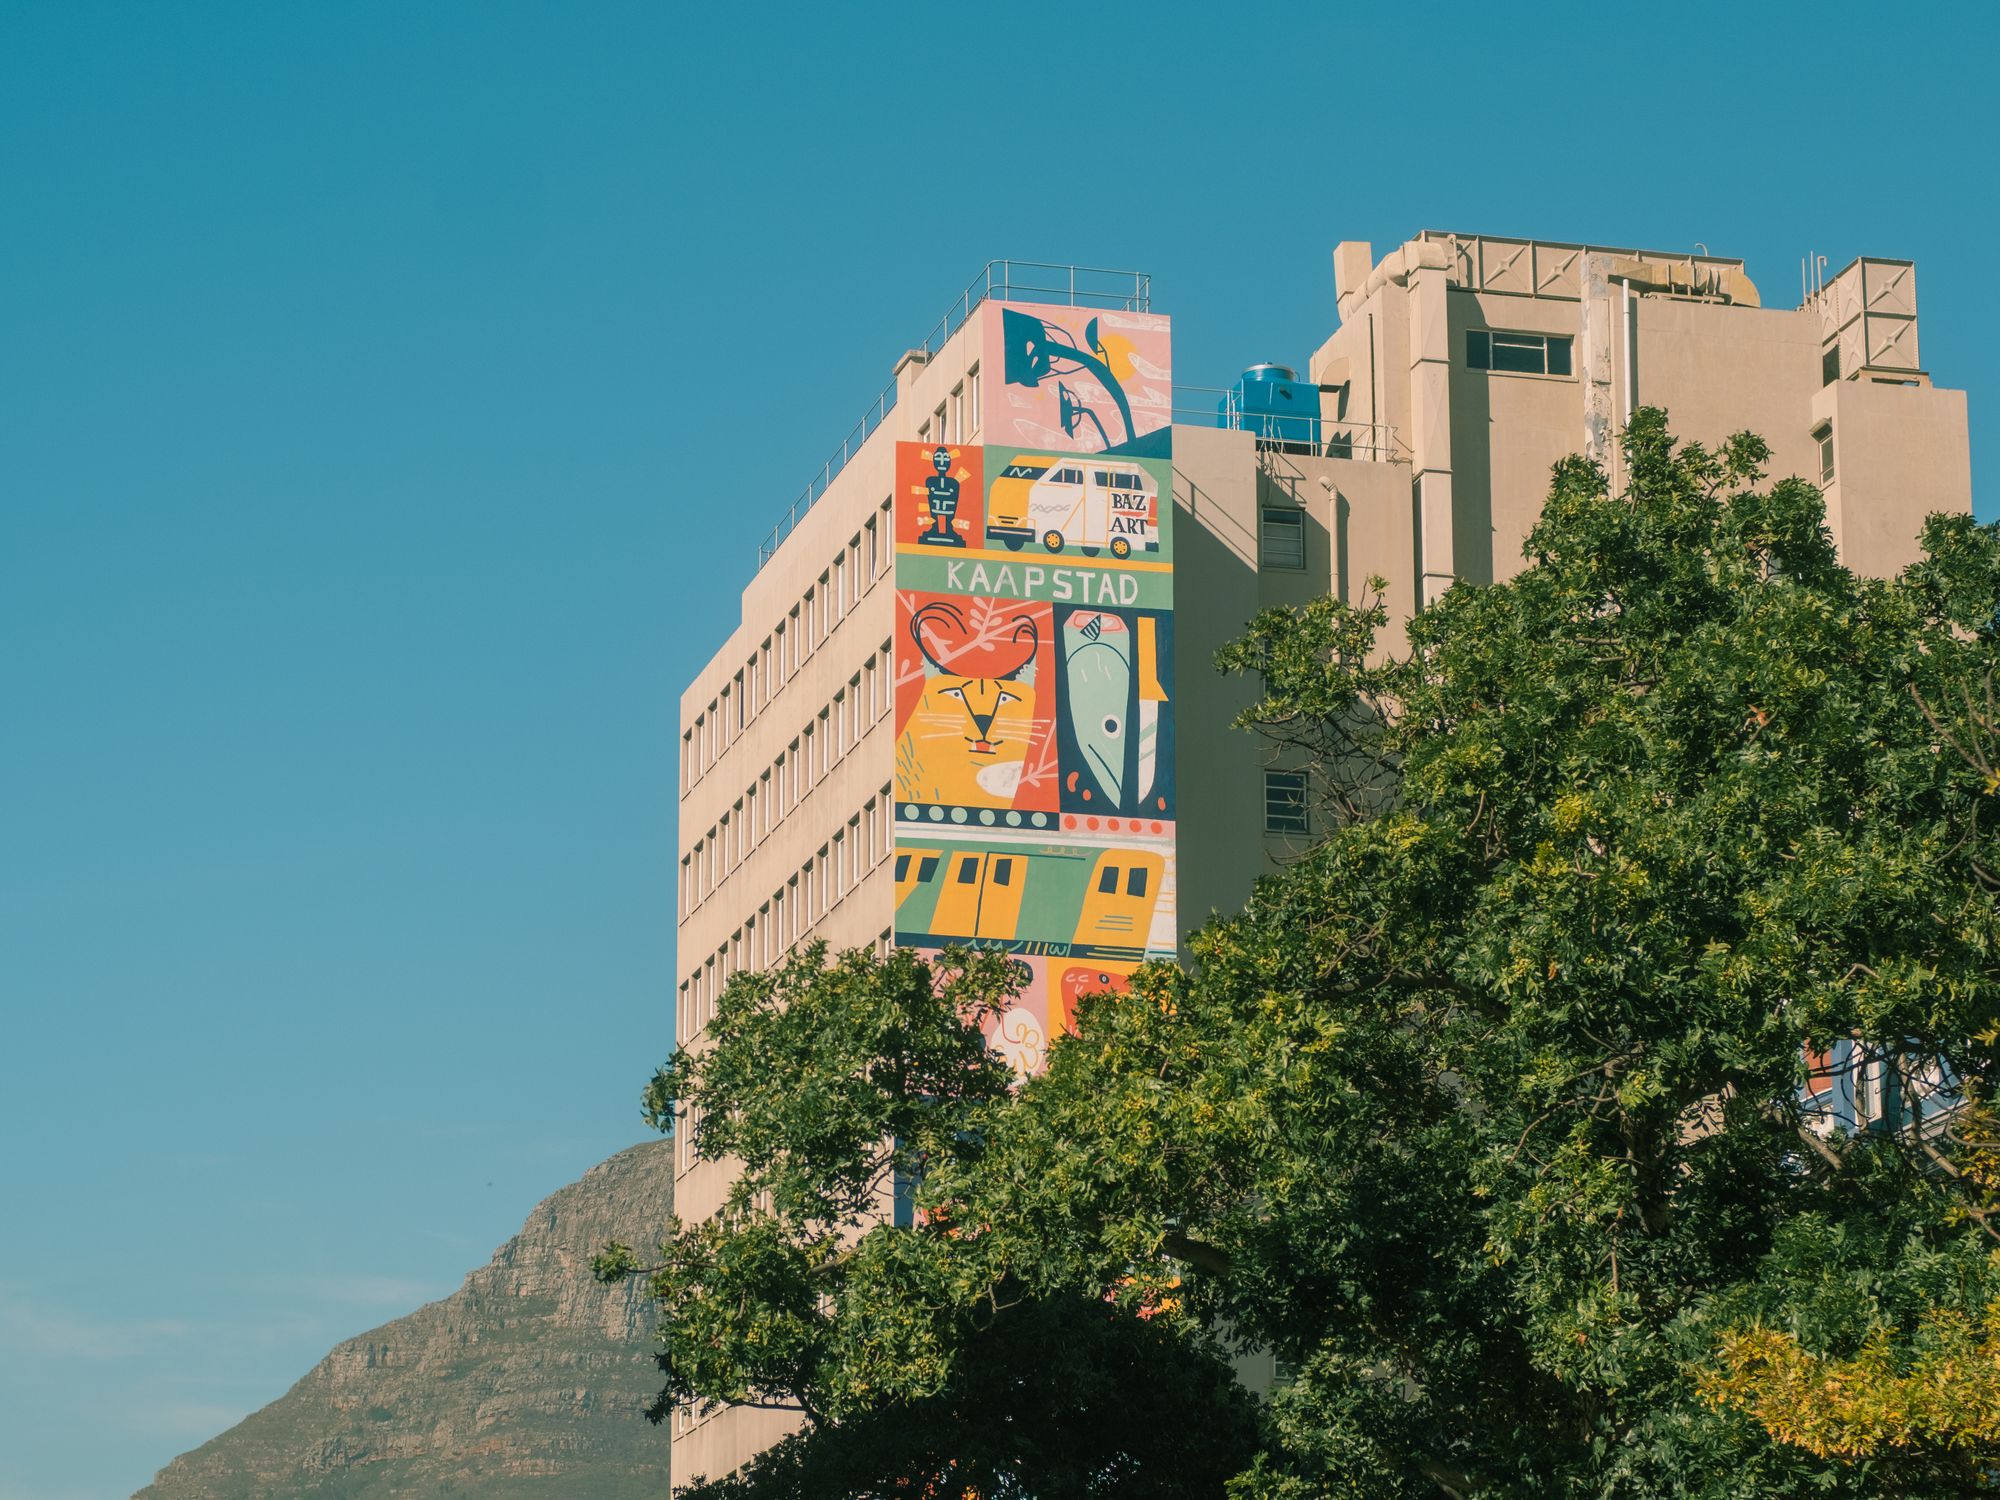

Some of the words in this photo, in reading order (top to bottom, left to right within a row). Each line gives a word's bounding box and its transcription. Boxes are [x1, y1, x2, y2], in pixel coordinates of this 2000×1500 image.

[1111, 493, 1147, 511] BAZ
[1109, 517, 1148, 535] ART
[948, 560, 1138, 605] KAAPSTAD
